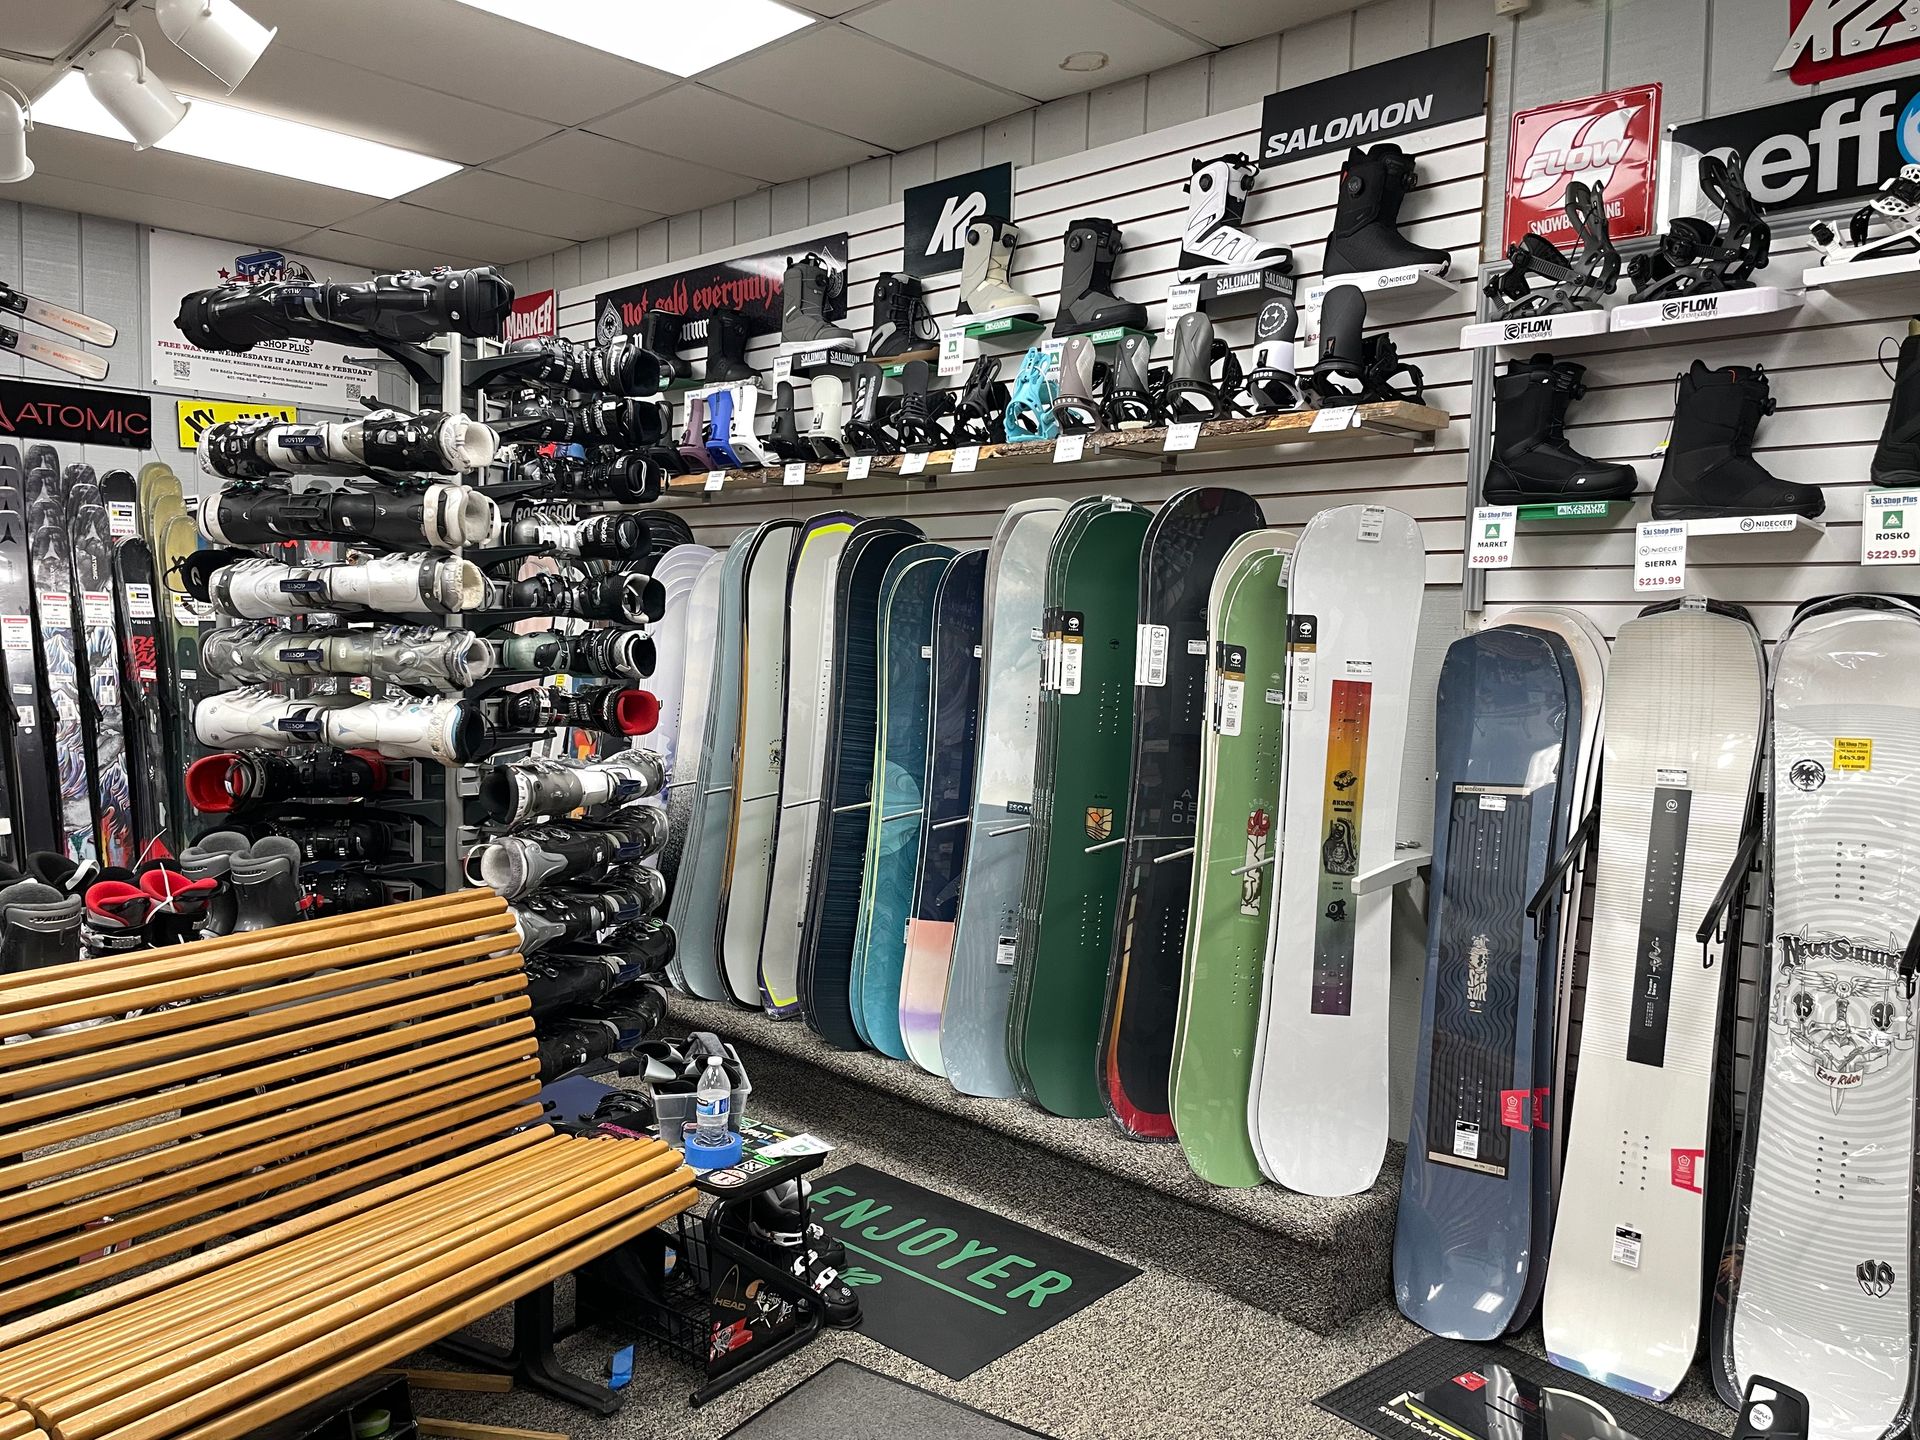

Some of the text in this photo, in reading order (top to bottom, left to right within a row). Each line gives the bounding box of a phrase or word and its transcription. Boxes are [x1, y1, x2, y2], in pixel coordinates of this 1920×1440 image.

[1264, 94, 1433, 159] SALOMON
[1697, 89, 1896, 203] eff
[1523, 139, 1630, 181] FLOW
[1530, 200, 1621, 235] SNOWBING
[1216, 272, 1261, 291] SALOMON
[1264, 272, 1294, 290] SALOMON
[1389, 273, 1416, 284] NIDECKER
[1680, 297, 1718, 314] FLOW
[507, 295, 553, 341] MARKER
[1520, 319, 1552, 334] FLOW
[263, 340, 287, 350] SHOP
[289, 343, 310, 353] PLUS
[157, 340, 181, 349] FREE
[218, 349, 273, 362] WEDNESDAYS
[275, 356, 284, 364] IN
[286, 358, 323, 370] JANUARY
[332, 365, 373, 377] FEBRUARY
[801, 351, 827, 363] SALOMON
[829, 351, 860, 364] SALOMON
[15, 402, 149, 435] ATOMIC
[1870, 495, 1917, 505] Ski Shop Plus
[1478, 511, 1487, 519] Ski
[1487, 511, 1500, 519] Shop
[1755, 519, 1793, 529] NIDECKER
[1642, 528, 1653, 536] Ski
[1653, 528, 1669, 536] Shop
[1875, 531, 1910, 541] ROSKO
[1477, 540, 1508, 548] MARKET
[1472, 555, 1508, 564] $209.99
[1866, 549, 1916, 559] $229.99
[1644, 559, 1678, 568] SIERRA
[1638, 576, 1682, 586] $219.99
[1816, 1066, 1861, 1086] Easy Rider
[809, 1184, 1073, 1308] ENJOYER
[712, 1297, 747, 1311] HEAD
[1377, 1405, 1412, 1425] SWISS
[1752, 1407, 1772, 1420] DISPLAY
